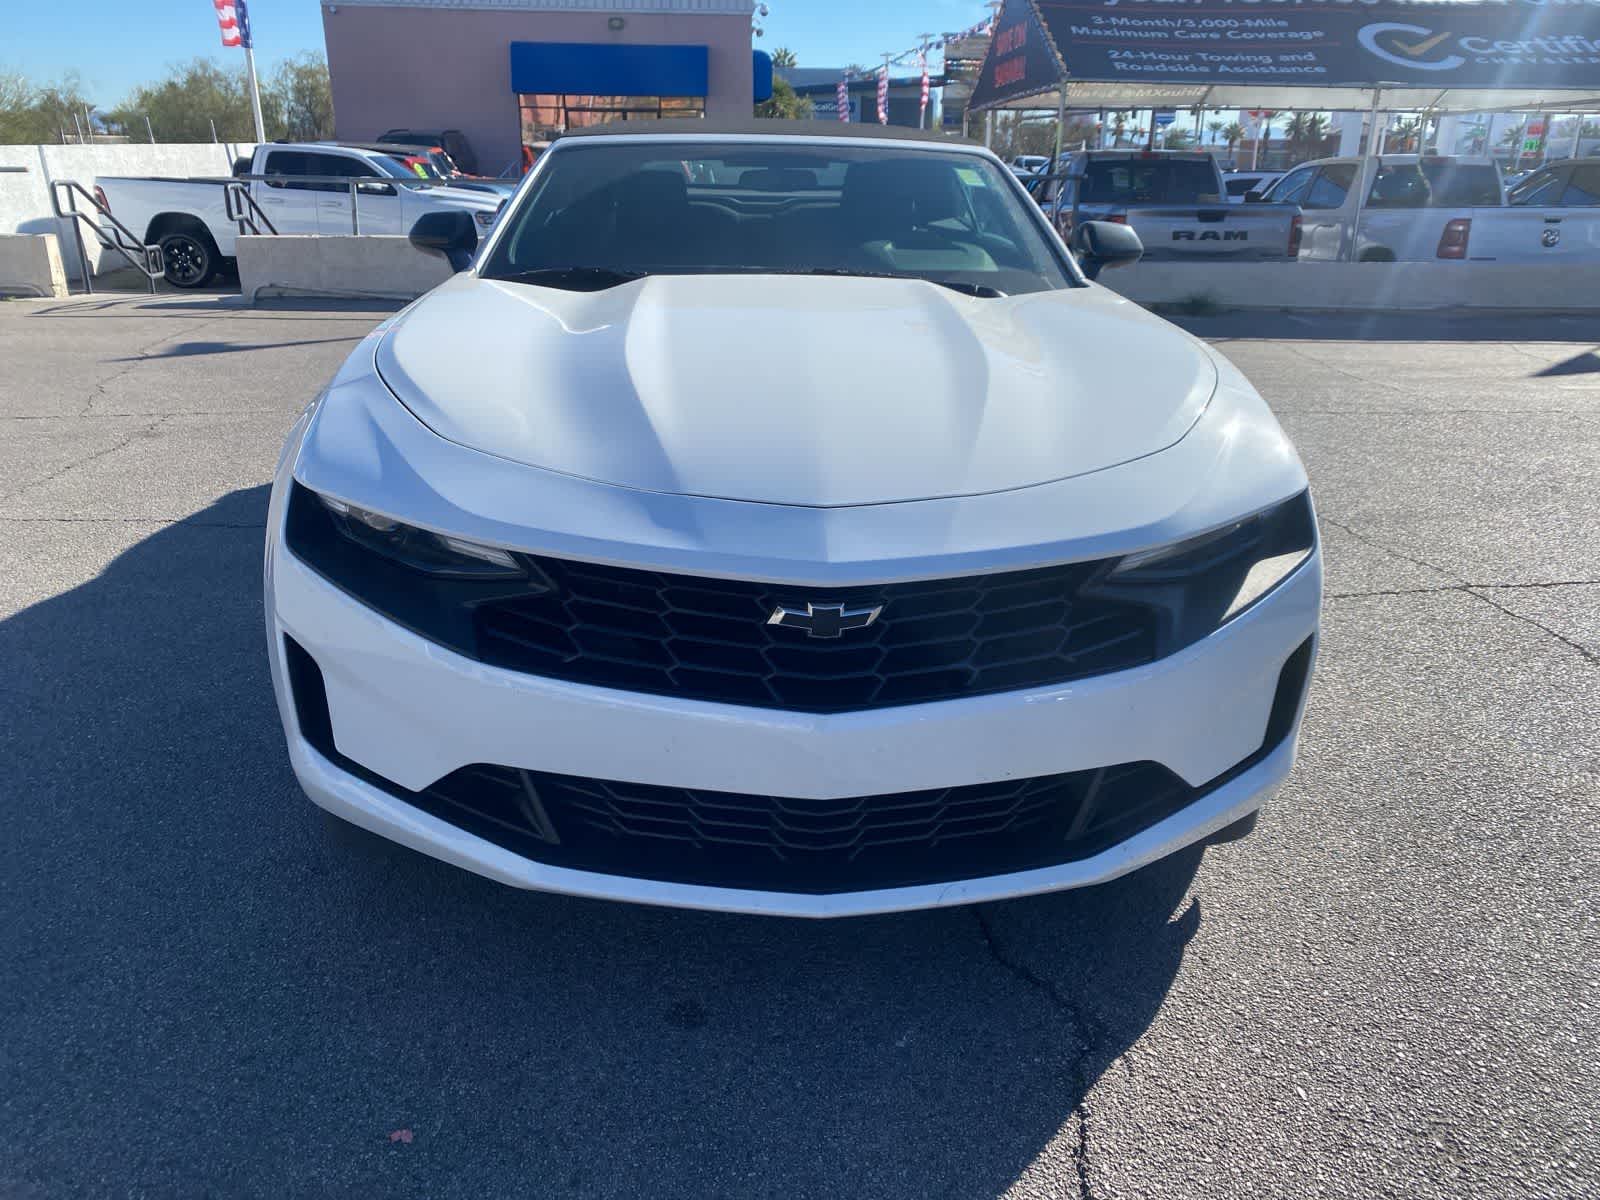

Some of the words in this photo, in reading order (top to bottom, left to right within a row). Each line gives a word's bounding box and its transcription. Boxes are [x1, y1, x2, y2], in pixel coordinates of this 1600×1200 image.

[1091, 16, 1288, 27] 3-Month/3,000-Mile
[1071, 26, 1168, 37] Maximum
[1174, 30, 1220, 39] Care
[1227, 30, 1324, 40] Coverage
[1108, 50, 1191, 61] 24-Hour
[1197, 52, 1273, 63] Towing
[1280, 51, 1316, 62] and
[1114, 63, 1209, 72] Roadside
[1217, 65, 1328, 73] Assistance
[1172, 231, 1247, 241] RAM
